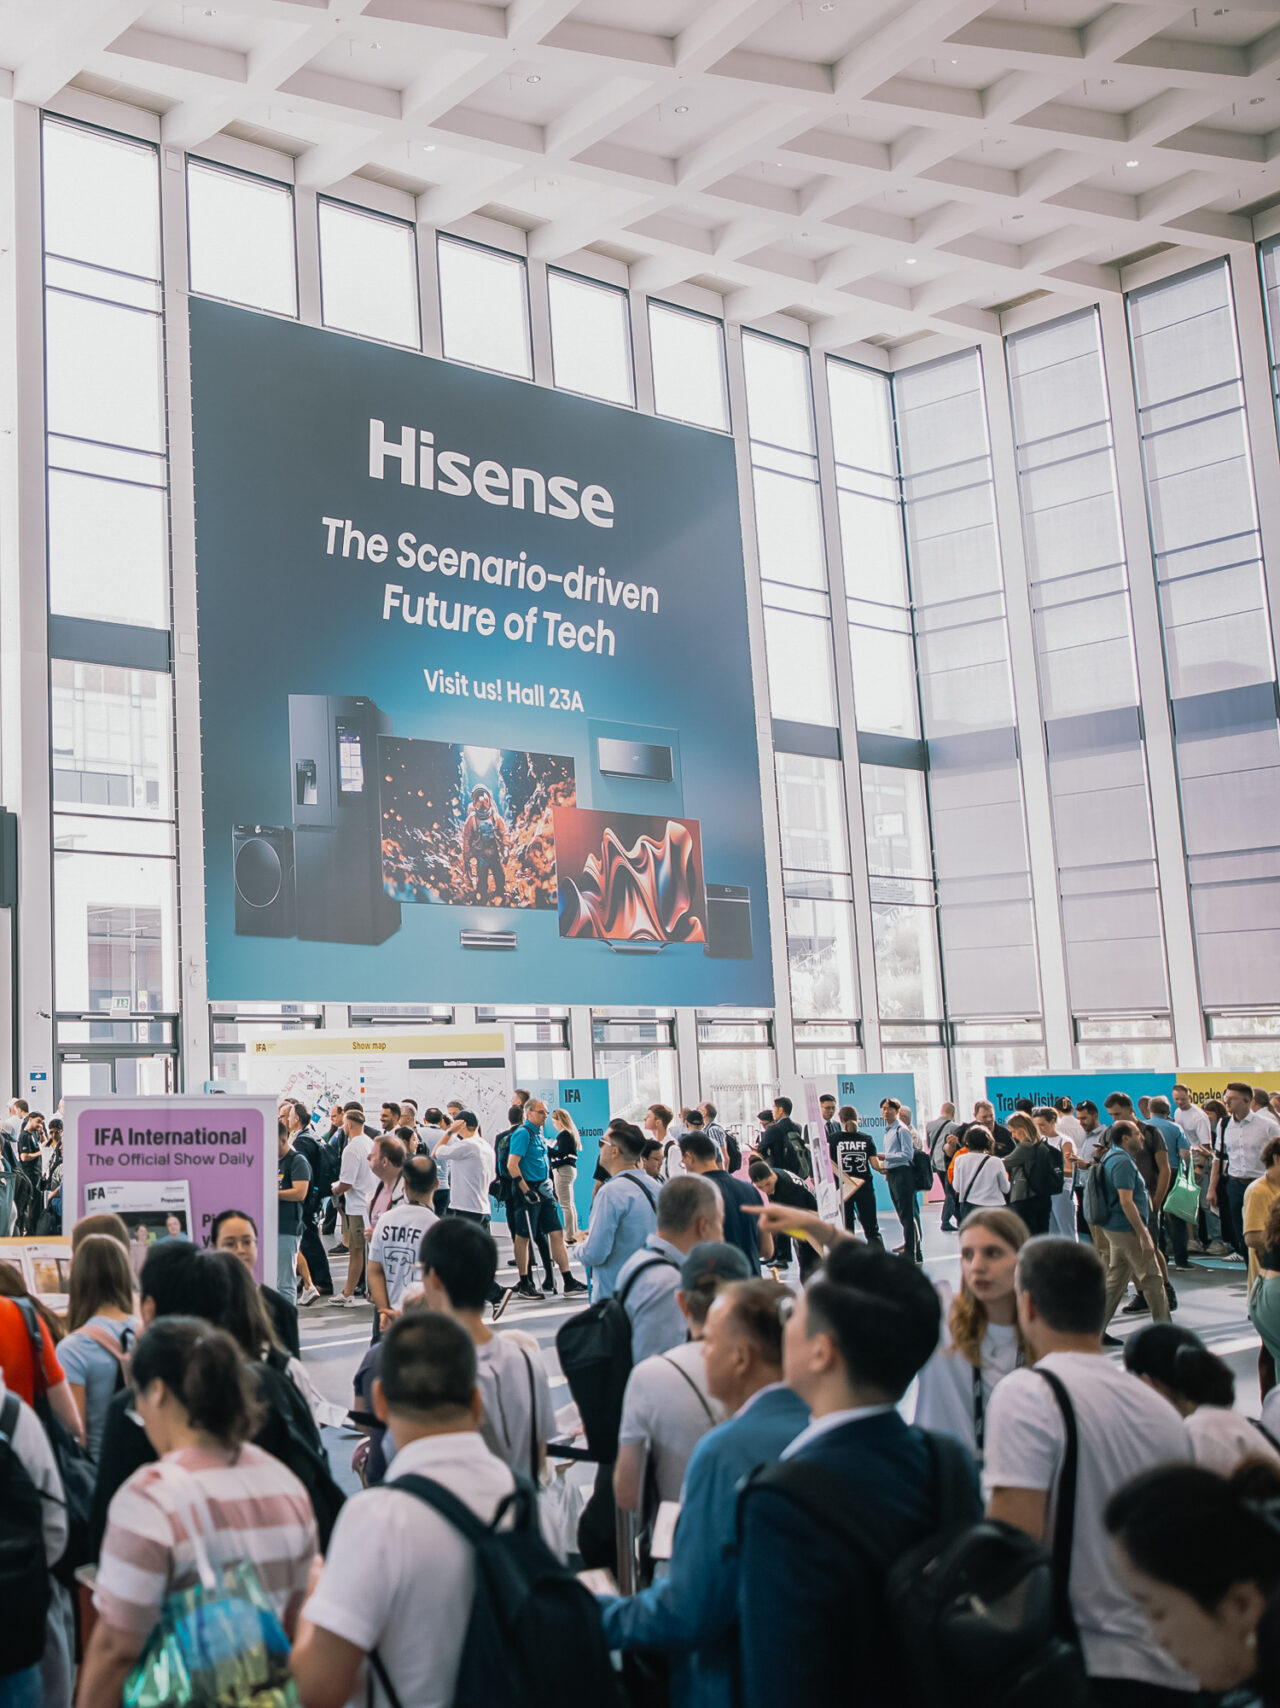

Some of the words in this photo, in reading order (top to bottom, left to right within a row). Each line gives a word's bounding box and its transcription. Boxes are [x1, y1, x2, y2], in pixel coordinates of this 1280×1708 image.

[369, 418, 615, 529] Hisense
[322, 516, 389, 563] The
[396, 531, 659, 614] Scenario-driven
[382, 583, 496, 636] Future
[503, 606, 538, 643] of
[543, 610, 616, 656] Tech
[423, 668, 470, 696] Visit
[473, 678, 503, 701] us!
[506, 681, 545, 707] Hall
[548, 687, 585, 712] 23A
[352, 1041, 372, 1050] Show
[372, 1041, 387, 1051] map
[564, 1089, 581, 1103] IFA
[842, 1082, 855, 1094] IFA
[94, 1128, 124, 1146] IFA
[128, 1127, 247, 1146] International
[837, 1141, 867, 1151] STAFF
[87, 1153, 114, 1166] The
[118, 1153, 170, 1166] Official
[174, 1152, 215, 1166] Show
[219, 1152, 254, 1168] Daily
[87, 1187, 106, 1201] IFA
[382, 1225, 422, 1244] STAFF
